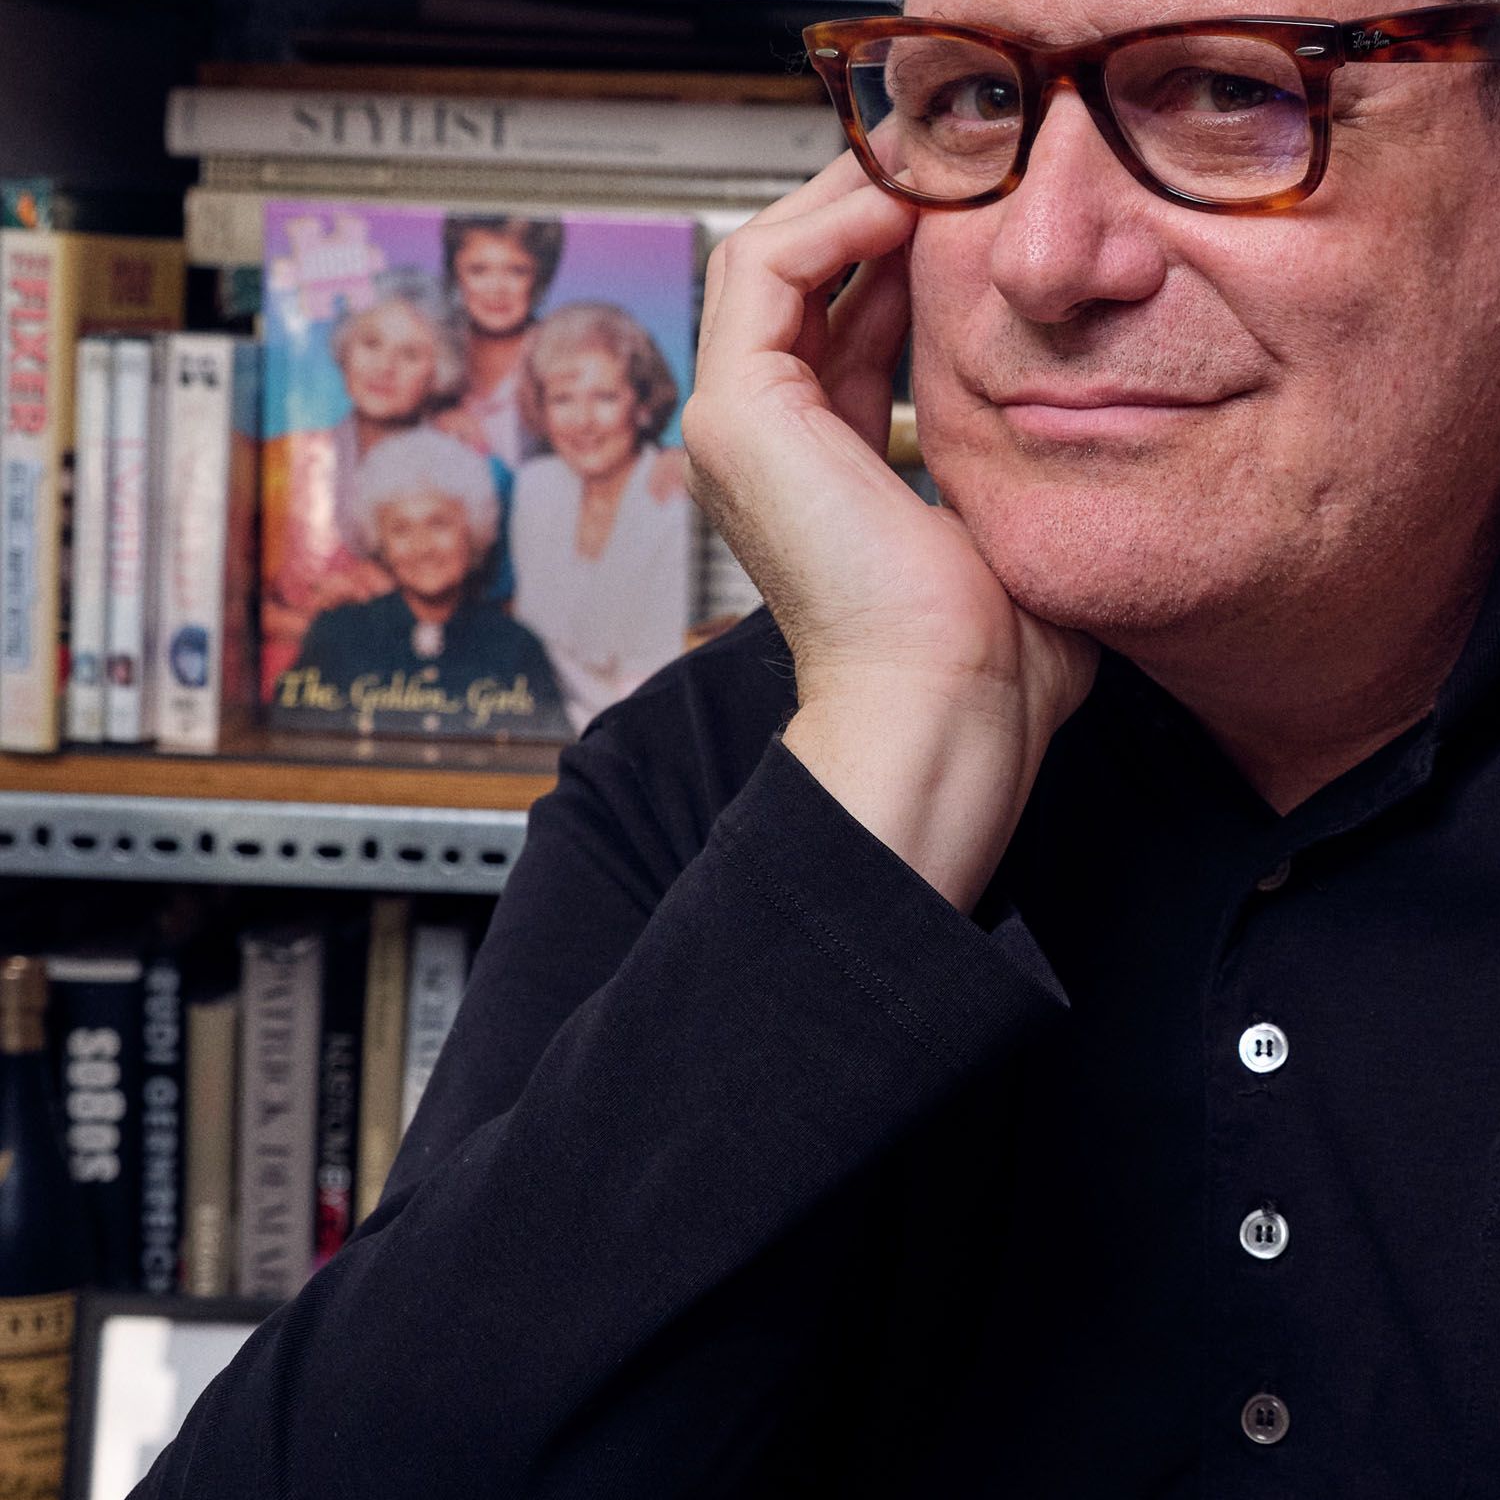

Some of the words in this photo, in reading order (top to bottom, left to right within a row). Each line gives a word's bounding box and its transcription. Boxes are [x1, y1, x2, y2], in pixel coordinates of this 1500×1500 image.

[291, 103, 517, 150] STYLIST
[278, 668, 342, 712] The
[350, 670, 462, 729] Golden
[466, 675, 535, 727] Girls
[144, 968, 179, 1065] RUDI
